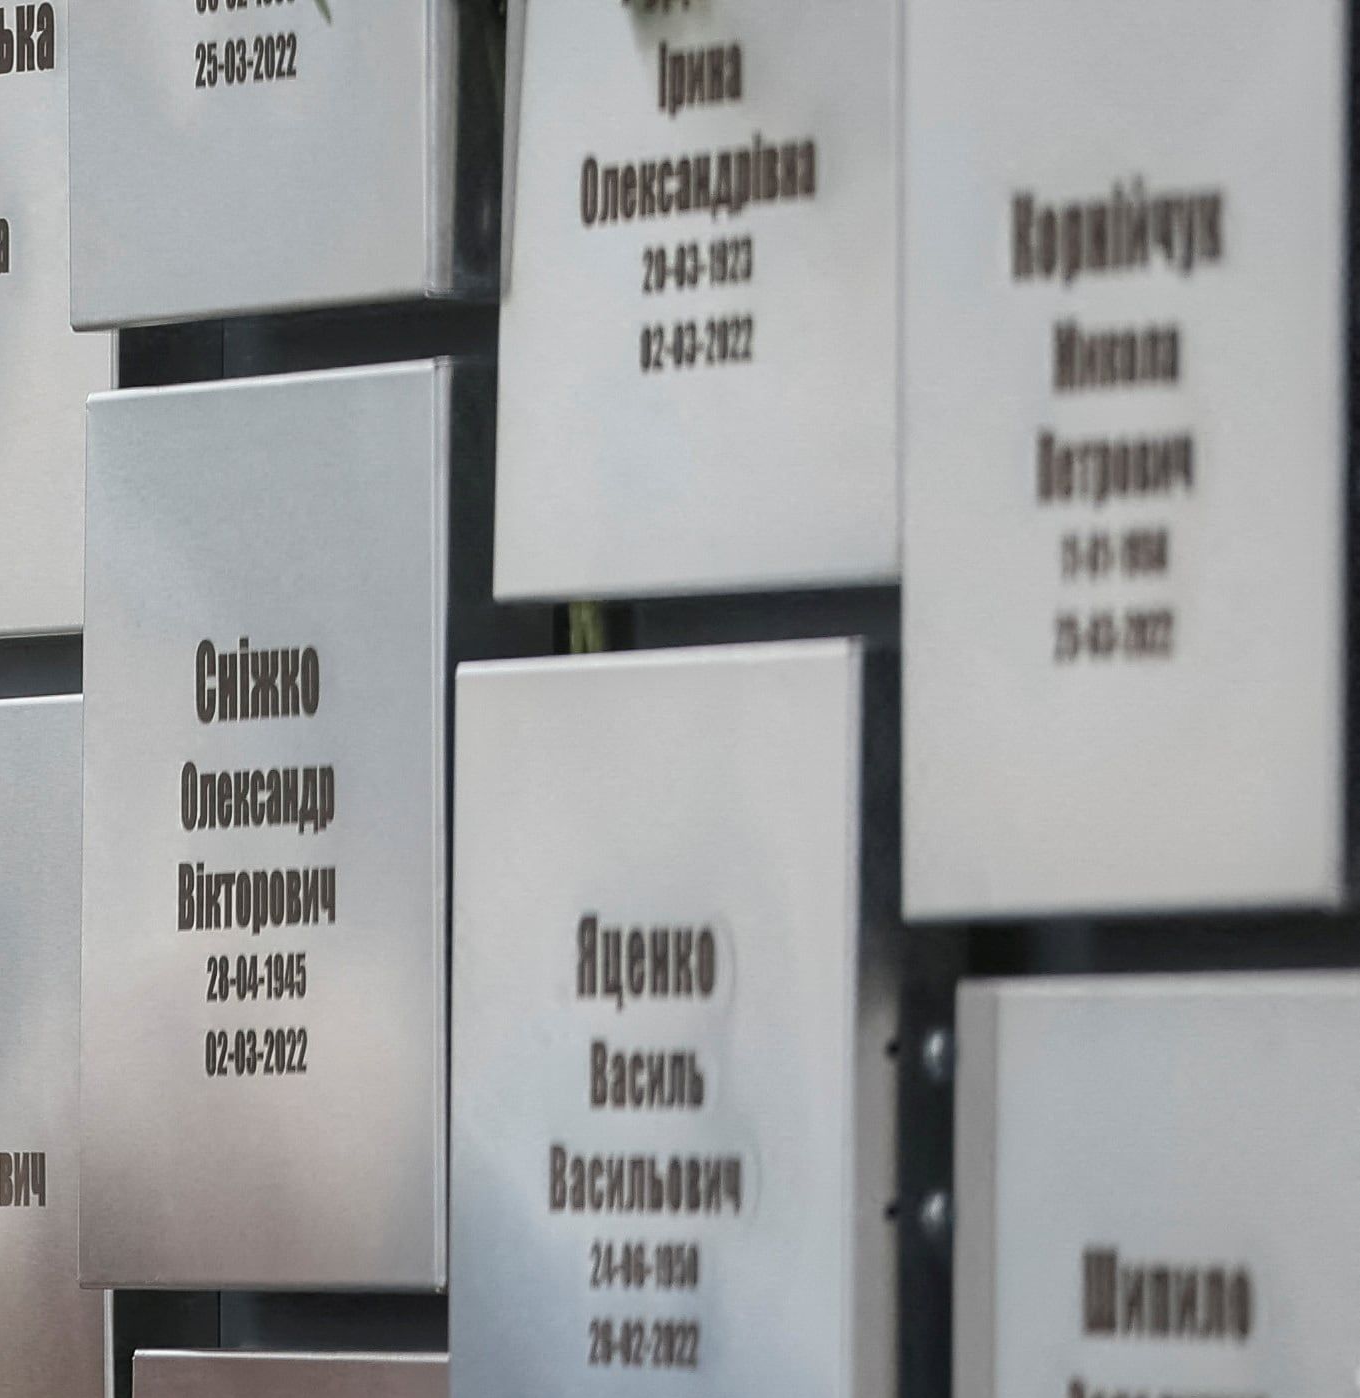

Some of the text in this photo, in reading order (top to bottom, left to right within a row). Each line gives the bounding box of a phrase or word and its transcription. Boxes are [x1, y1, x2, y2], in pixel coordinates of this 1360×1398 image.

[195, 32, 298, 88] 25-03-2022
[657, 38, 743, 115] Ірина
[580, 133, 818, 227] Олександрівна
[639, 315, 754, 373] 02-03-2022
[195, 637, 320, 724] Сніжко
[181, 761, 335, 834] Олександр
[177, 861, 336, 935] Вікторович
[206, 952, 307, 1002] 28-04-1945
[577, 914, 717, 1010] Яценко
[205, 1027, 308, 1078] 02-03-2022
[590, 1040, 706, 1110] Василь
[549, 1143, 743, 1216] Васильович
